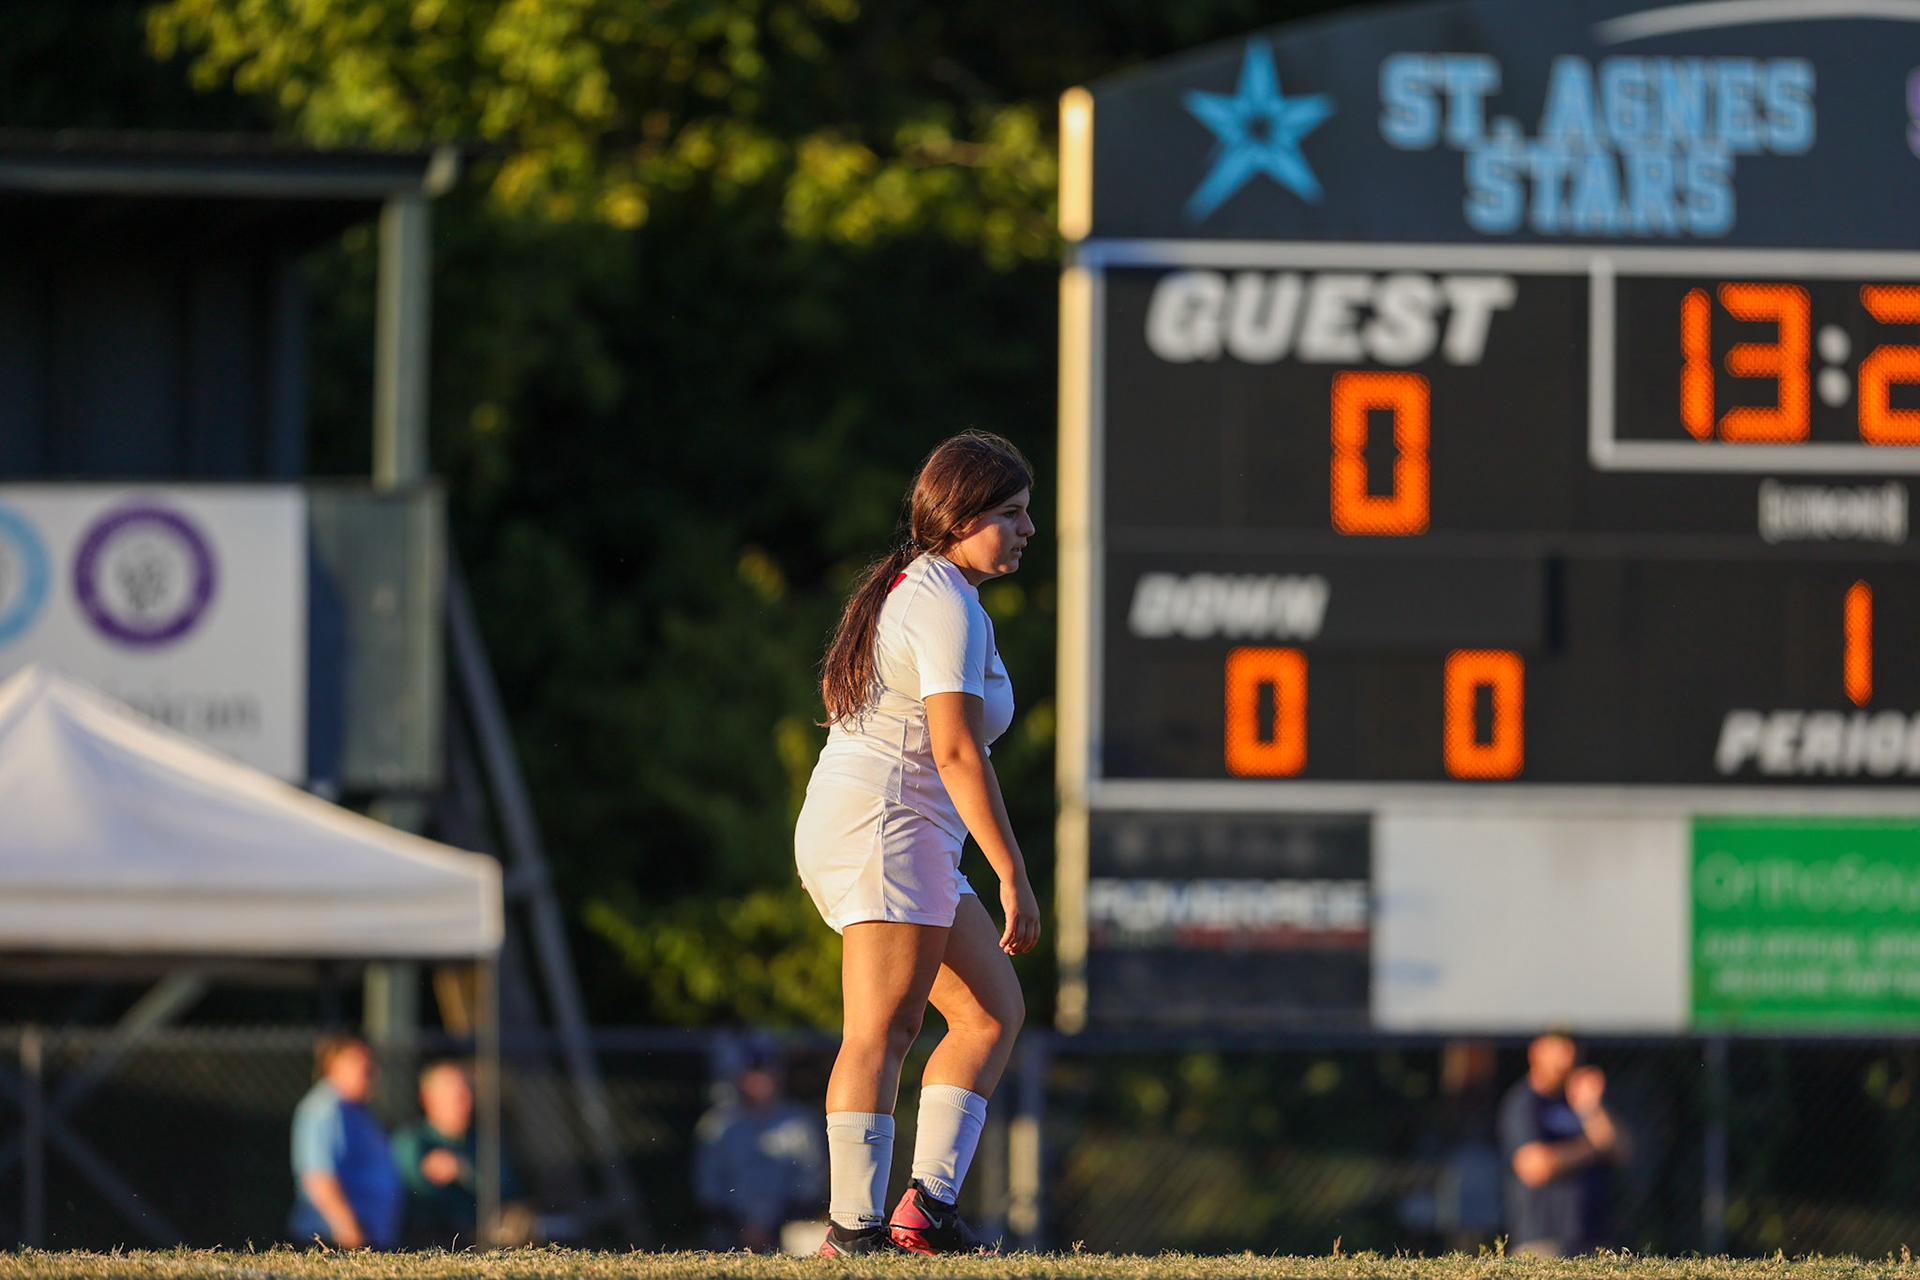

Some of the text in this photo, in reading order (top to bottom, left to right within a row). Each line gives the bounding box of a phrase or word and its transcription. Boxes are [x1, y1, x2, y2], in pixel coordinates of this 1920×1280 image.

[1538, 55, 1817, 156] AGNES
[1465, 138, 1737, 236] STARS
[1145, 271, 1517, 366] GUEST
[1330, 371, 1431, 536] 0
[1128, 572, 1329, 640] DOWN
[1844, 579, 1873, 708] 1
[1225, 646, 1309, 778] 0
[1444, 649, 1525, 780] 0
